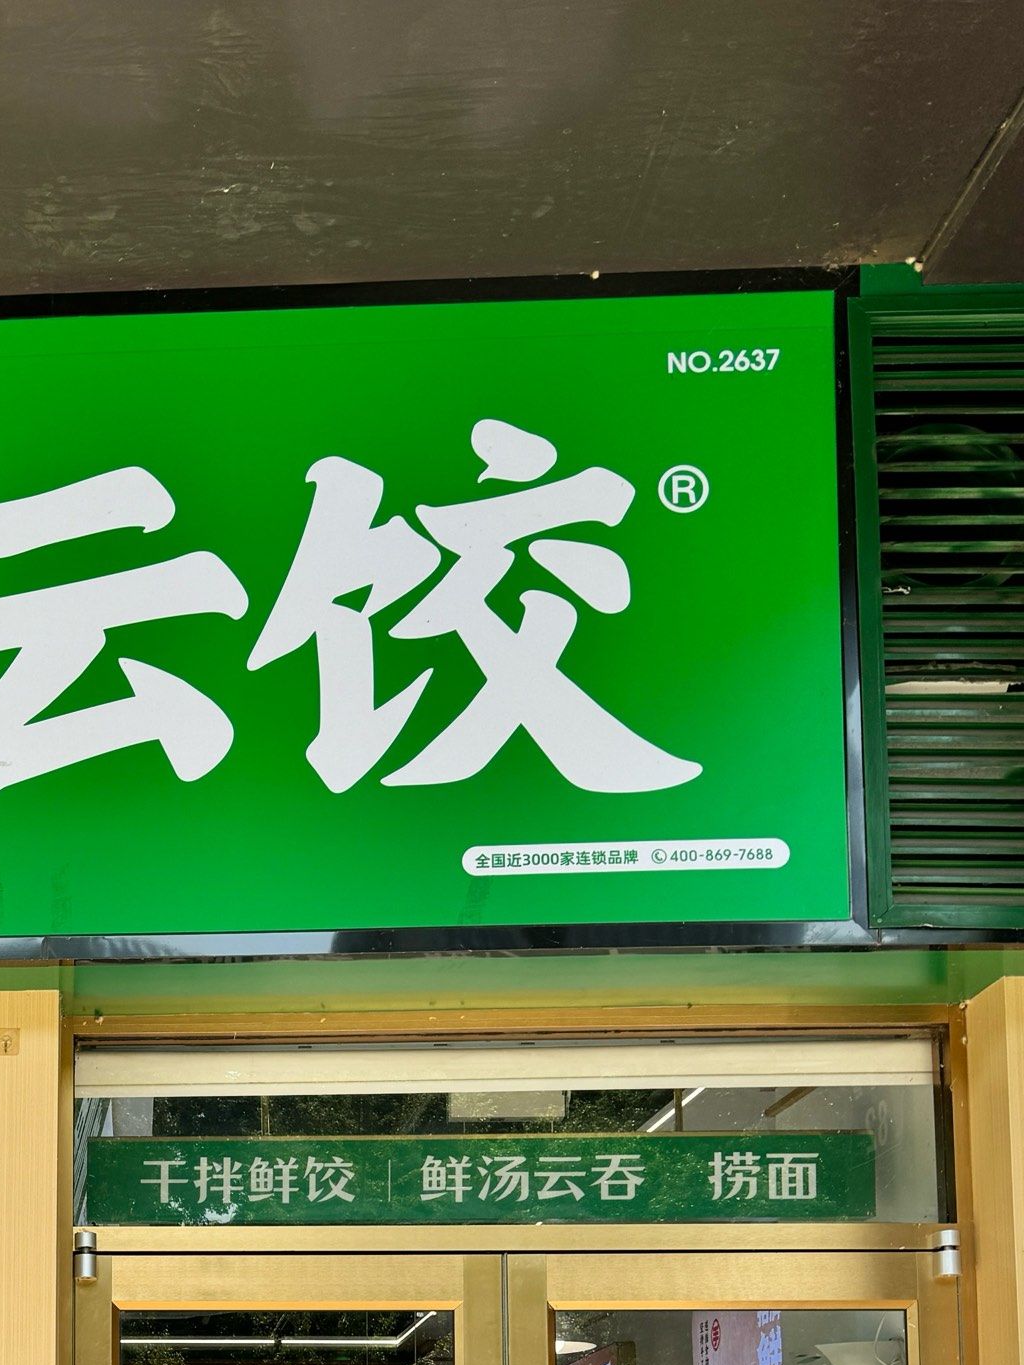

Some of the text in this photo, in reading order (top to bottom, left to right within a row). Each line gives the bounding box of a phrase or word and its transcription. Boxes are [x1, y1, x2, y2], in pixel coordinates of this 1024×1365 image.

[667, 349, 780, 374] NO.2637
[475, 849, 639, 869] 全国近3000家连锁品牌
[670, 848, 774, 863] 400-869-7688
[140, 1151, 819, 1205] 干拌鲜饺 鲜汤云吞 捞面
